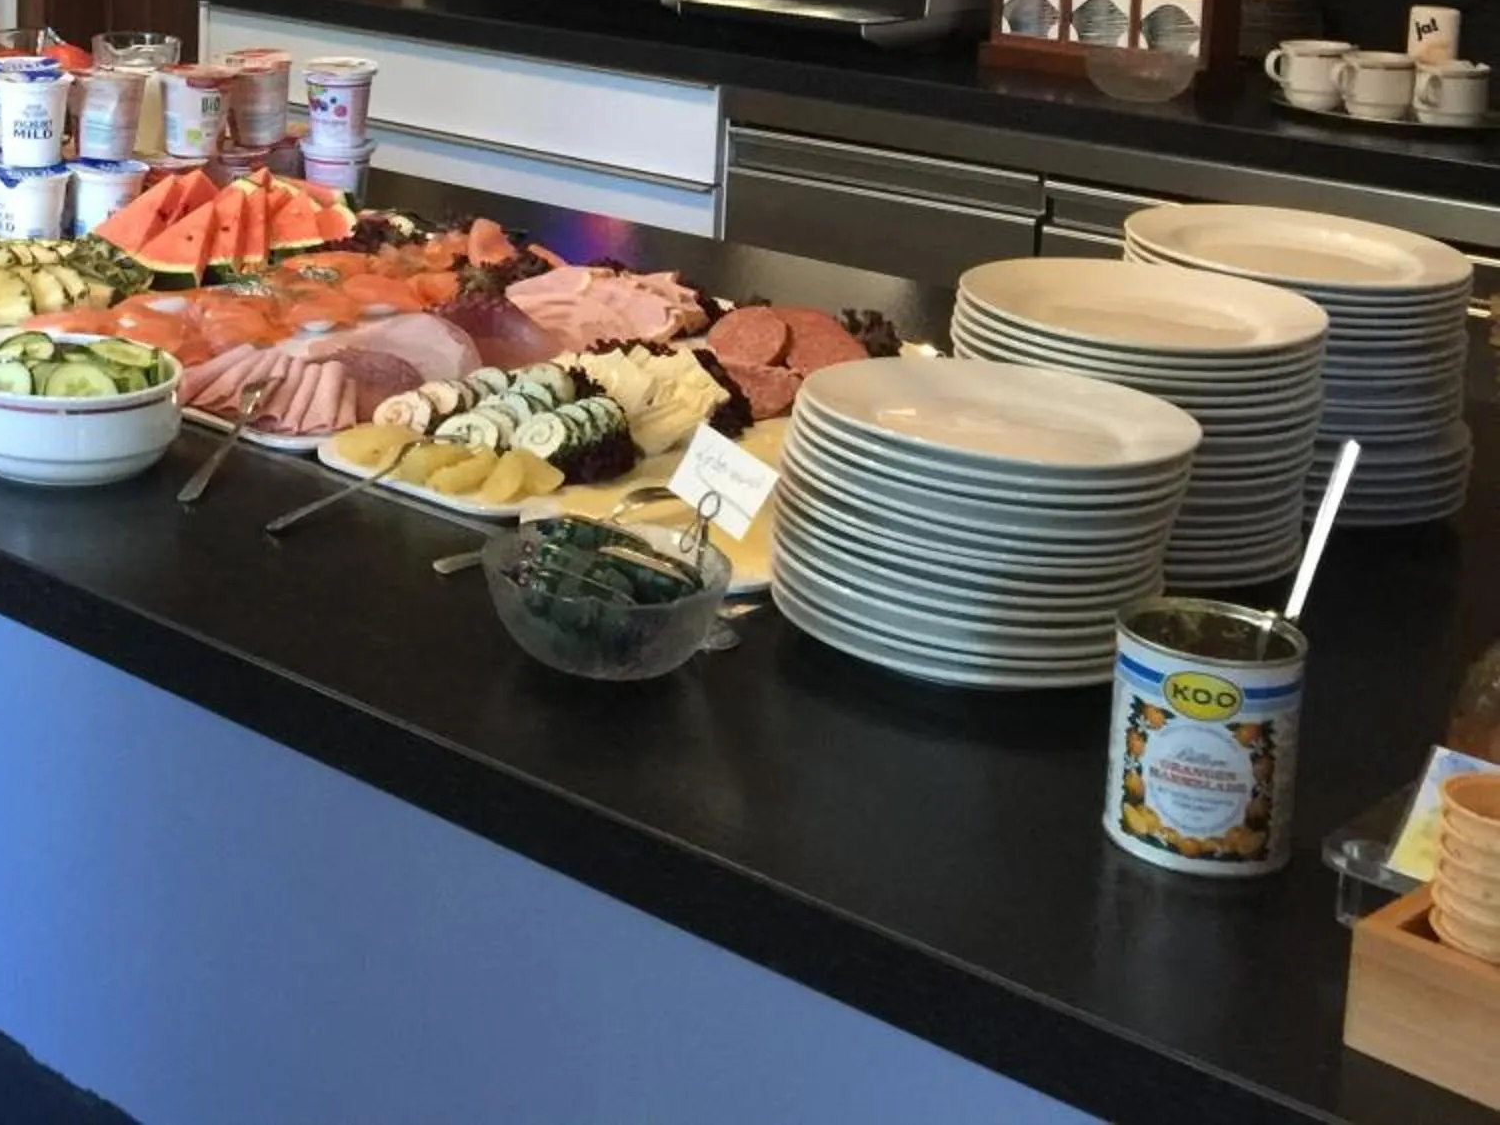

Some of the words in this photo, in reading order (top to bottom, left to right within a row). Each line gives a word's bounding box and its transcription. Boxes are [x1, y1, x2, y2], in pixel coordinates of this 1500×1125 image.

[1414, 16, 1439, 42] ja!
[13, 129, 53, 140] MILD
[1171, 682, 1238, 709] KOO
